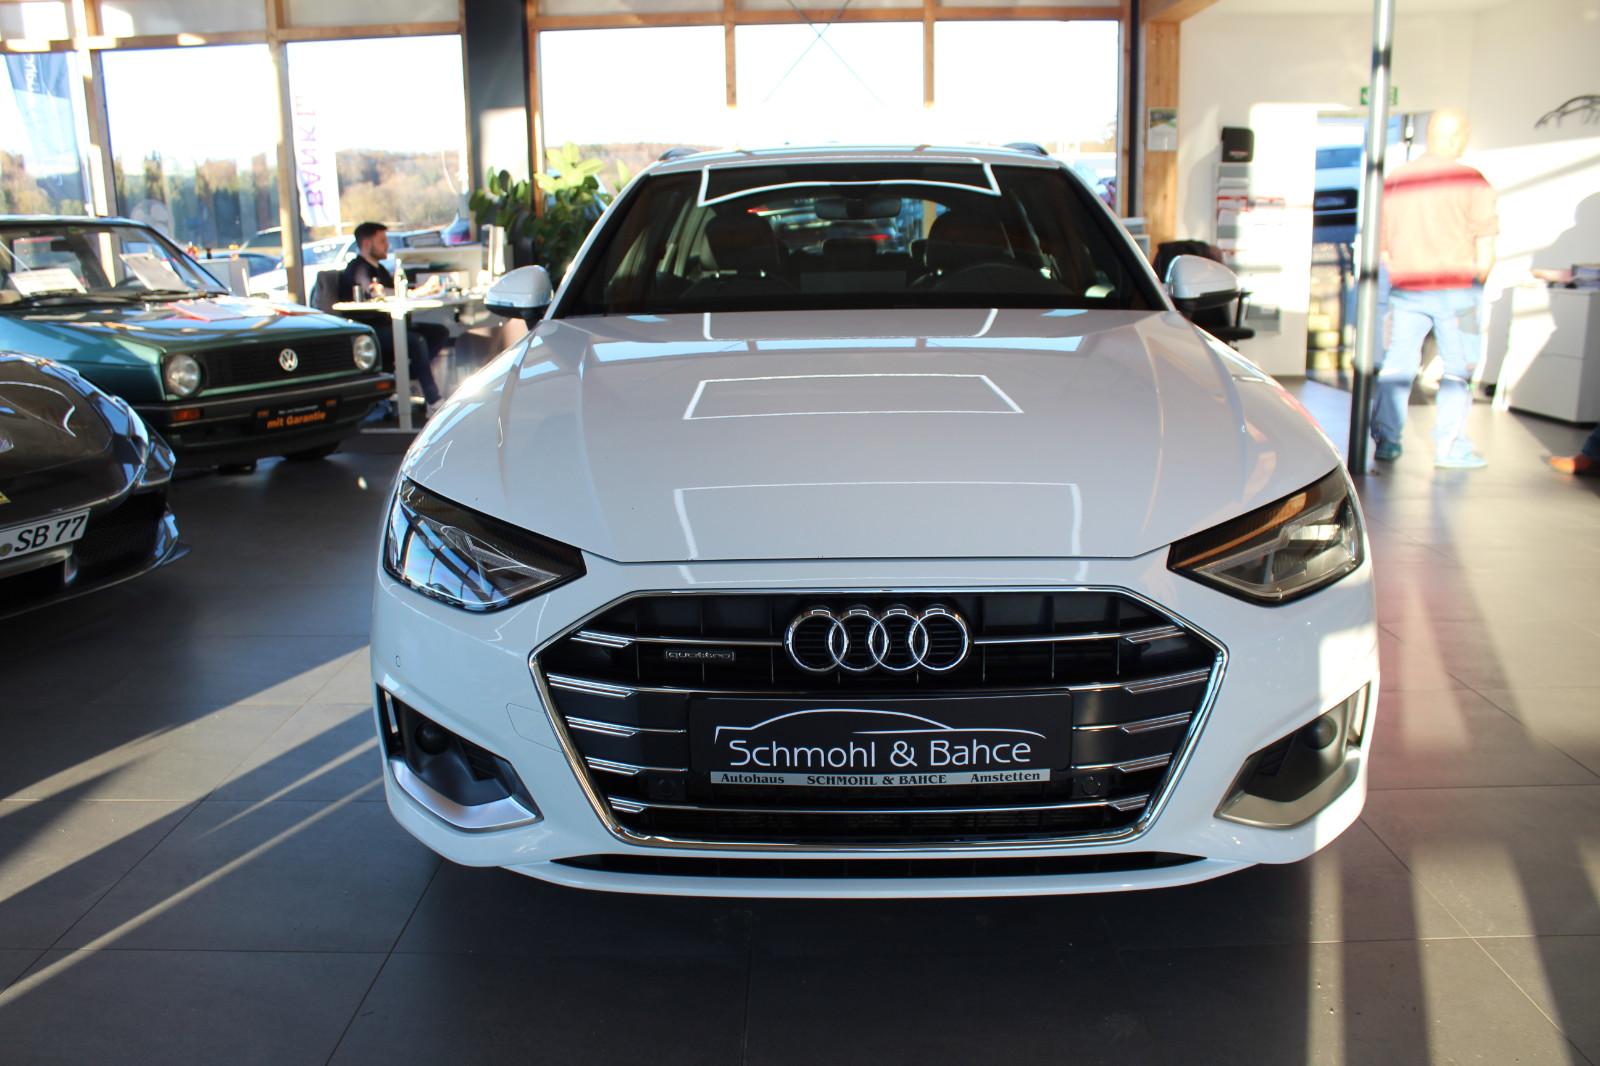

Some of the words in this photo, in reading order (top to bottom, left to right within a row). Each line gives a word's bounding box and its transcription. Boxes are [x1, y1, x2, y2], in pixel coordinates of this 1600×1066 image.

[266, 416, 284, 429] mit
[286, 411, 326, 426] Garantie
[14, 525, 50, 552] SB
[55, 515, 86, 542] 77
[667, 650, 731, 661] quattro
[729, 740, 876, 768] Schmohl
[890, 740, 918, 767] &
[930, 738, 1031, 766] Bahce
[721, 773, 785, 784] Autohaus
[807, 775, 877, 786] SCHMOHL
[882, 775, 895, 785] &
[899, 774, 947, 785] BAHCE
[970, 771, 1040, 783] Amstetten
